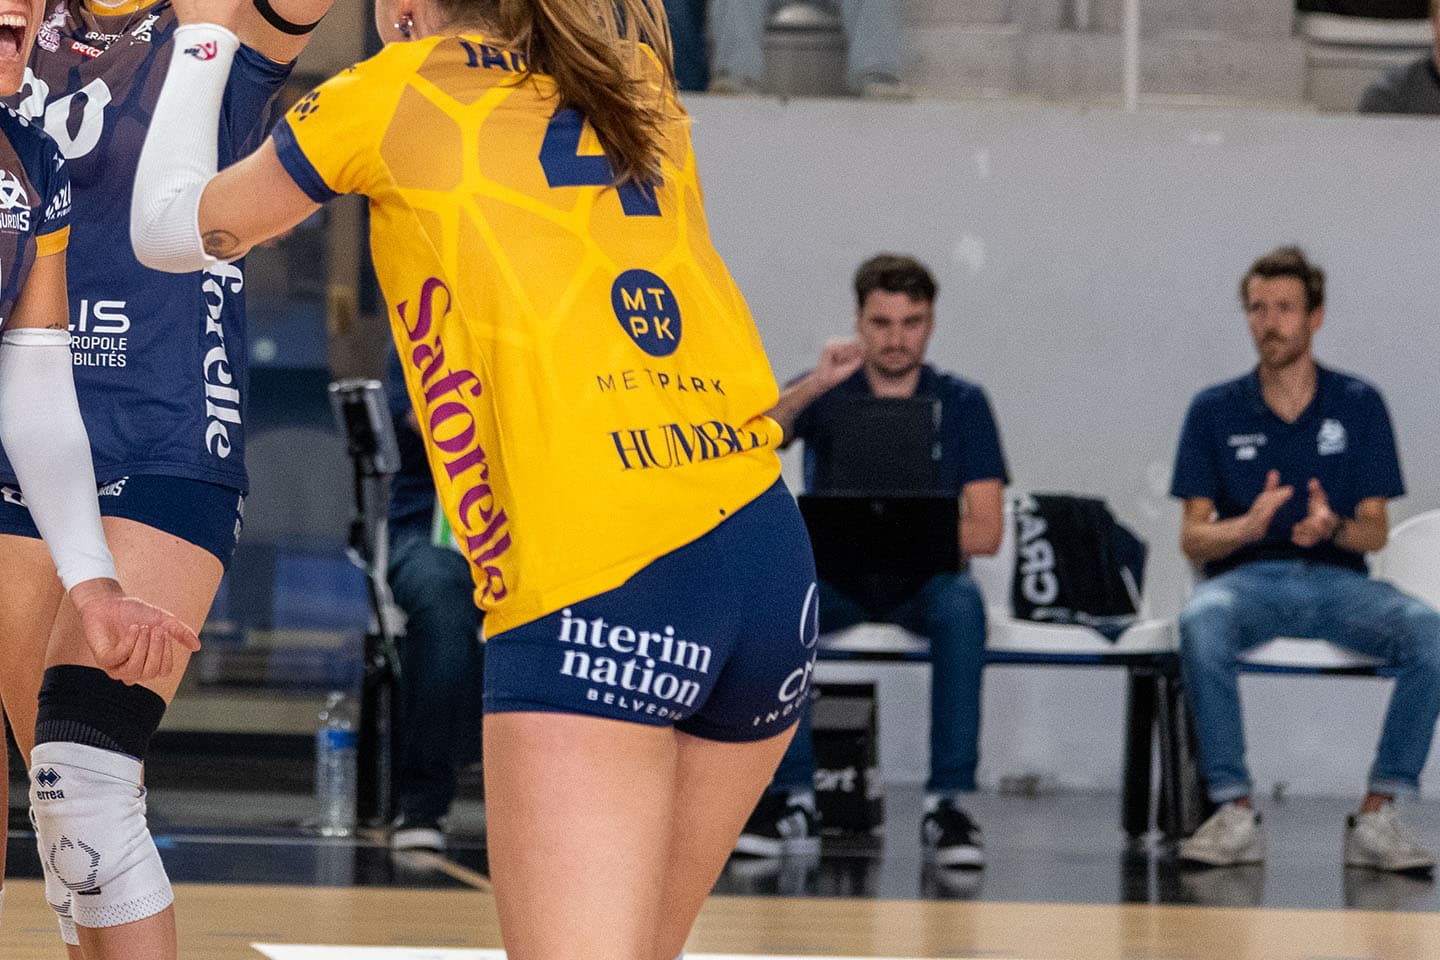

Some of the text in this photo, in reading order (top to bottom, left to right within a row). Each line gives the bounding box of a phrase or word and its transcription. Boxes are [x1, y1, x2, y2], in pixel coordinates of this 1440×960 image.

[538, 104, 665, 217] 4
[620, 287, 666, 311] MT
[628, 315, 676, 341] PK
[396, 276, 513, 602] Saforelle
[558, 607, 712, 675] interim
[560, 648, 702, 708] nation
